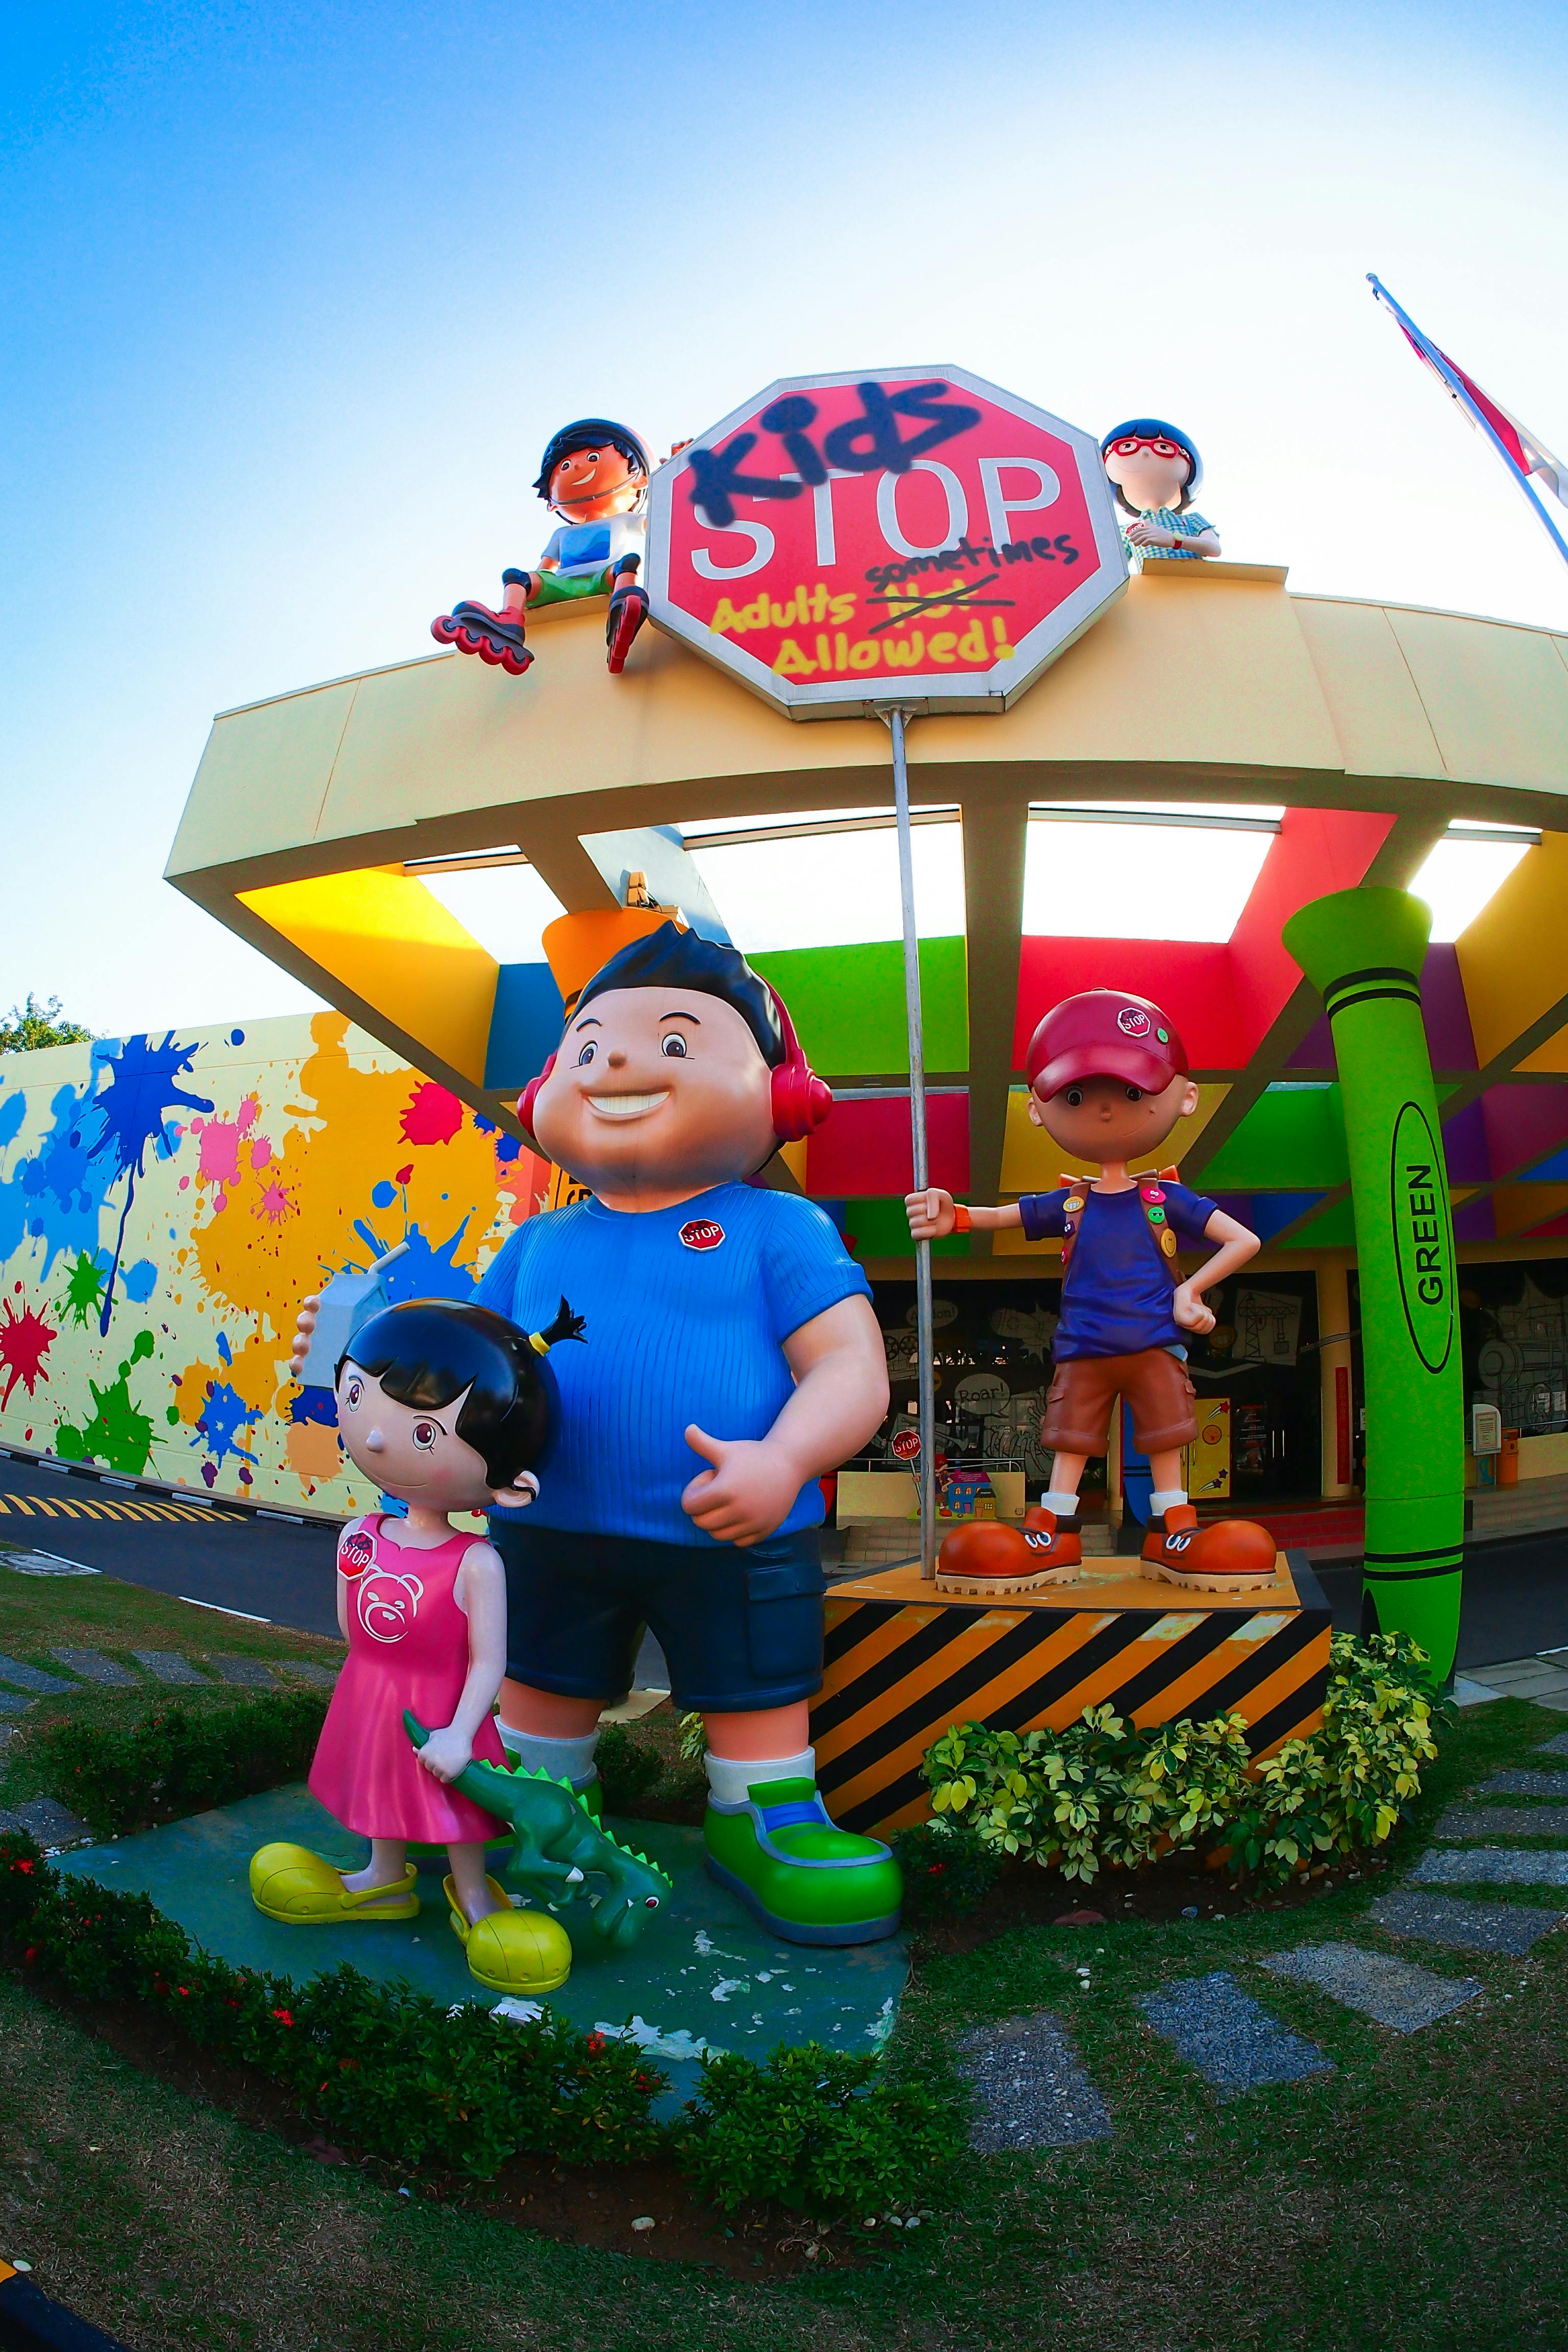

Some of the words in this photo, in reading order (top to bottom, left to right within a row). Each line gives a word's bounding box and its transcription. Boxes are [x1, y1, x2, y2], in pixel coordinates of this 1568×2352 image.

[688, 383, 982, 527] Kids
[691, 456, 1061, 580] STOP
[865, 534, 1079, 593] sometimes
[710, 583, 857, 633] Adults
[772, 616, 1016, 675] Allowed!
[1122, 1014, 1145, 1030] STOP
[684, 1226, 719, 1242] STOP
[1406, 1165, 1443, 1305] GREEN
[911, 1306, 954, 1321] Aion!
[958, 1382, 1004, 1403] Roar!
[894, 1438, 918, 1452] STOP
[341, 1541, 370, 1567] STOP
